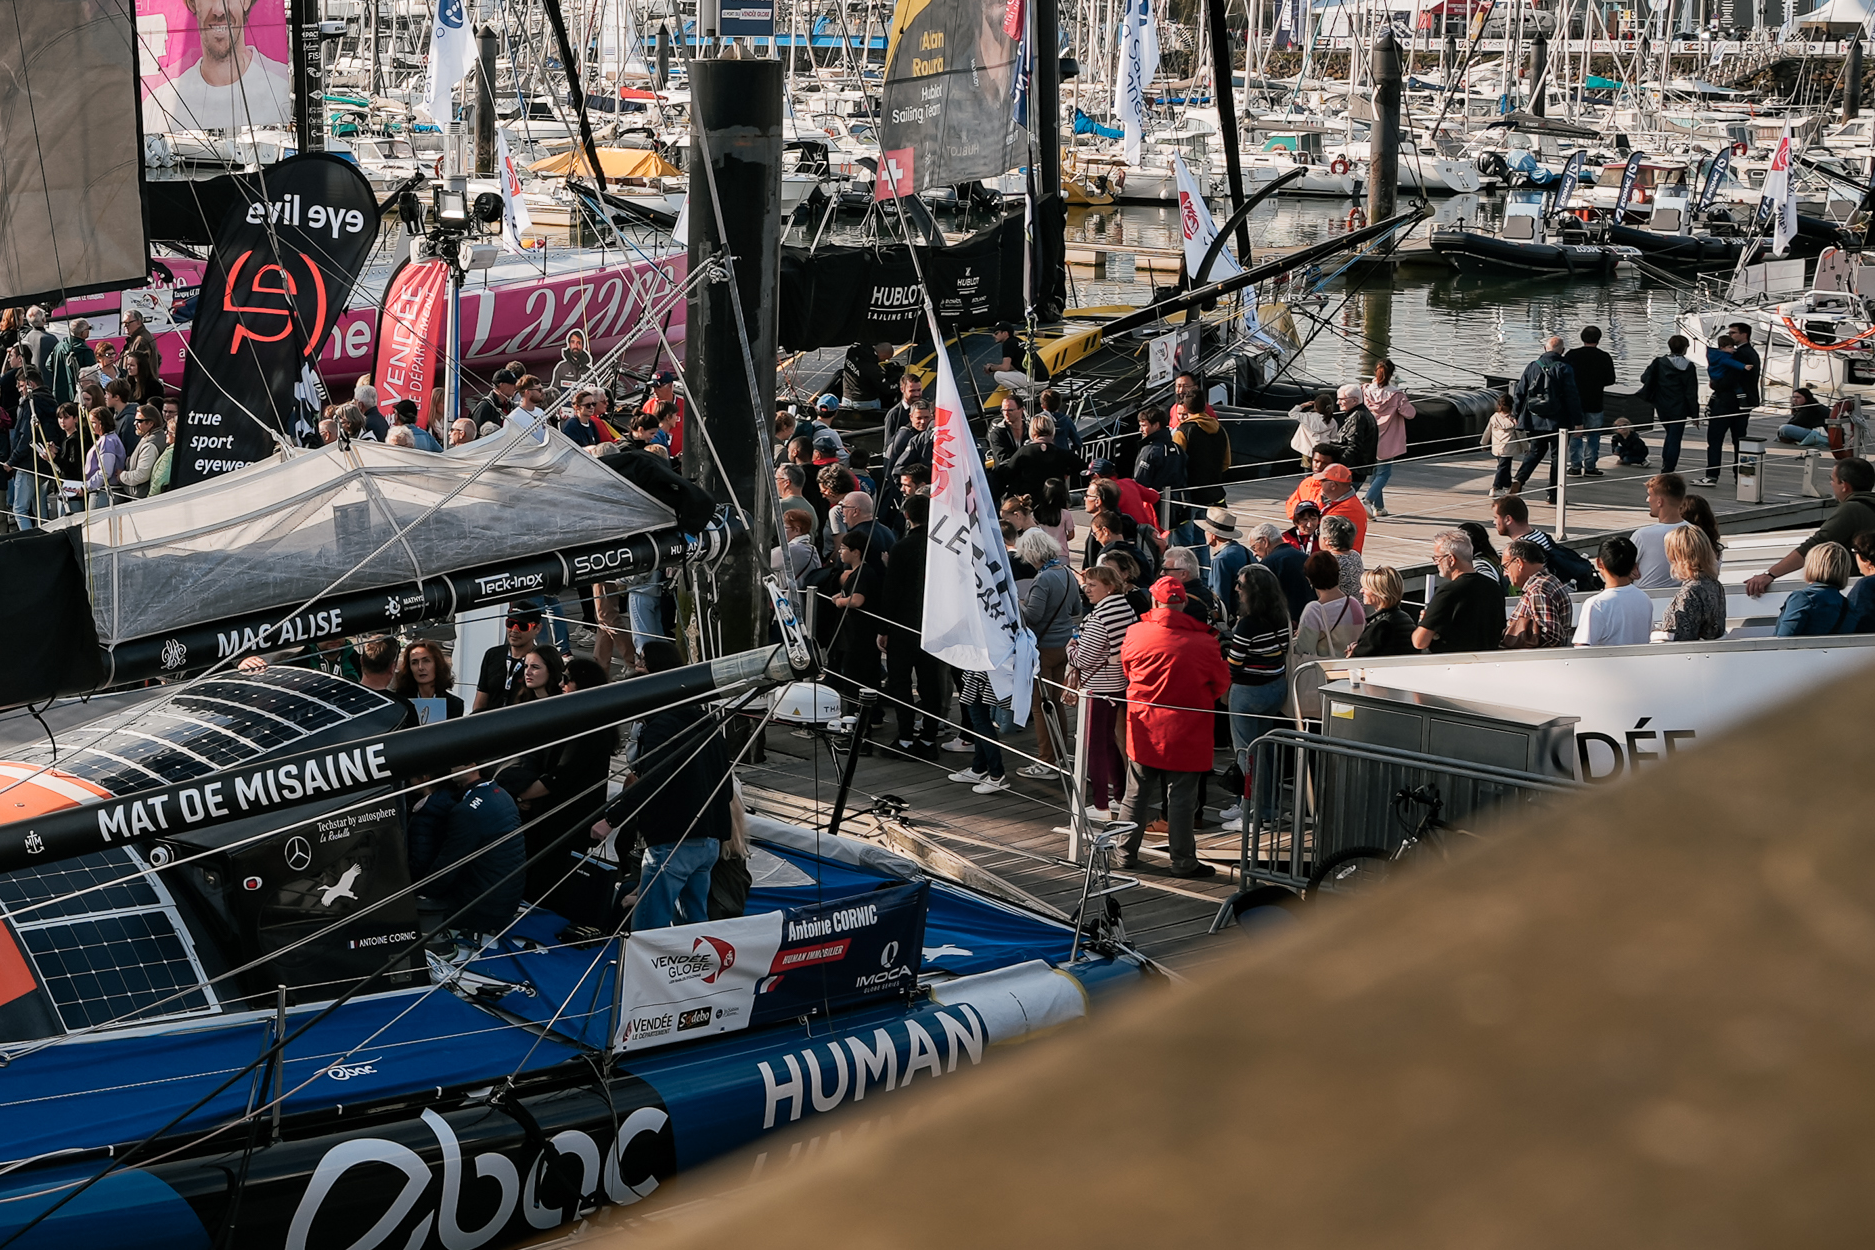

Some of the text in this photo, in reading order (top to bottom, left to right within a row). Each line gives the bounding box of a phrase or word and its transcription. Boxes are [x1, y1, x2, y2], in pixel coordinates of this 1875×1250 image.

[921, 31, 944, 51] Alan
[912, 56, 944, 77] Roura
[921, 83, 943, 102] Hublot
[892, 106, 924, 125] Sailing
[1559, 177, 1574, 208] ZODIAC
[1619, 177, 1632, 208] ZODIAC
[1707, 170, 1721, 199] ZODIAC
[245, 194, 300, 227] evil
[871, 284, 923, 306] HUBLOT
[466, 264, 675, 360] Lazare
[867, 311, 902, 321] SAILING
[381, 285, 422, 408] VENDÉE
[409, 291, 435, 391] DÉPARTEMENT
[187, 409, 222, 426] true
[189, 433, 234, 451] sport
[575, 548, 633, 574] SOCA
[475, 572, 543, 596] Teck-Inox
[217, 608, 343, 659] MAC ALISE
[97, 743, 393, 843] MAT DE MISAINE
[316, 807, 396, 833] Techstar by autosphere
[320, 827, 350, 843] La Rochelle
[788, 904, 878, 942] Antoine CORNIC
[359, 931, 417, 949] ANTOINE CORNIC
[650, 951, 712, 970] VENDÉE
[782, 945, 844, 966] HUMAN IMMOBILIER
[668, 963, 710, 979] GLOBE
[856, 964, 913, 988] IMOCA
[864, 981, 900, 994] GLOBE SERIES
[632, 1012, 673, 1033] VENDÉE
[678, 1010, 710, 1028] Sodebo
[632, 1027, 671, 1040] LE DÉPARTEMENT
[757, 1003, 991, 1131] HUMAN
